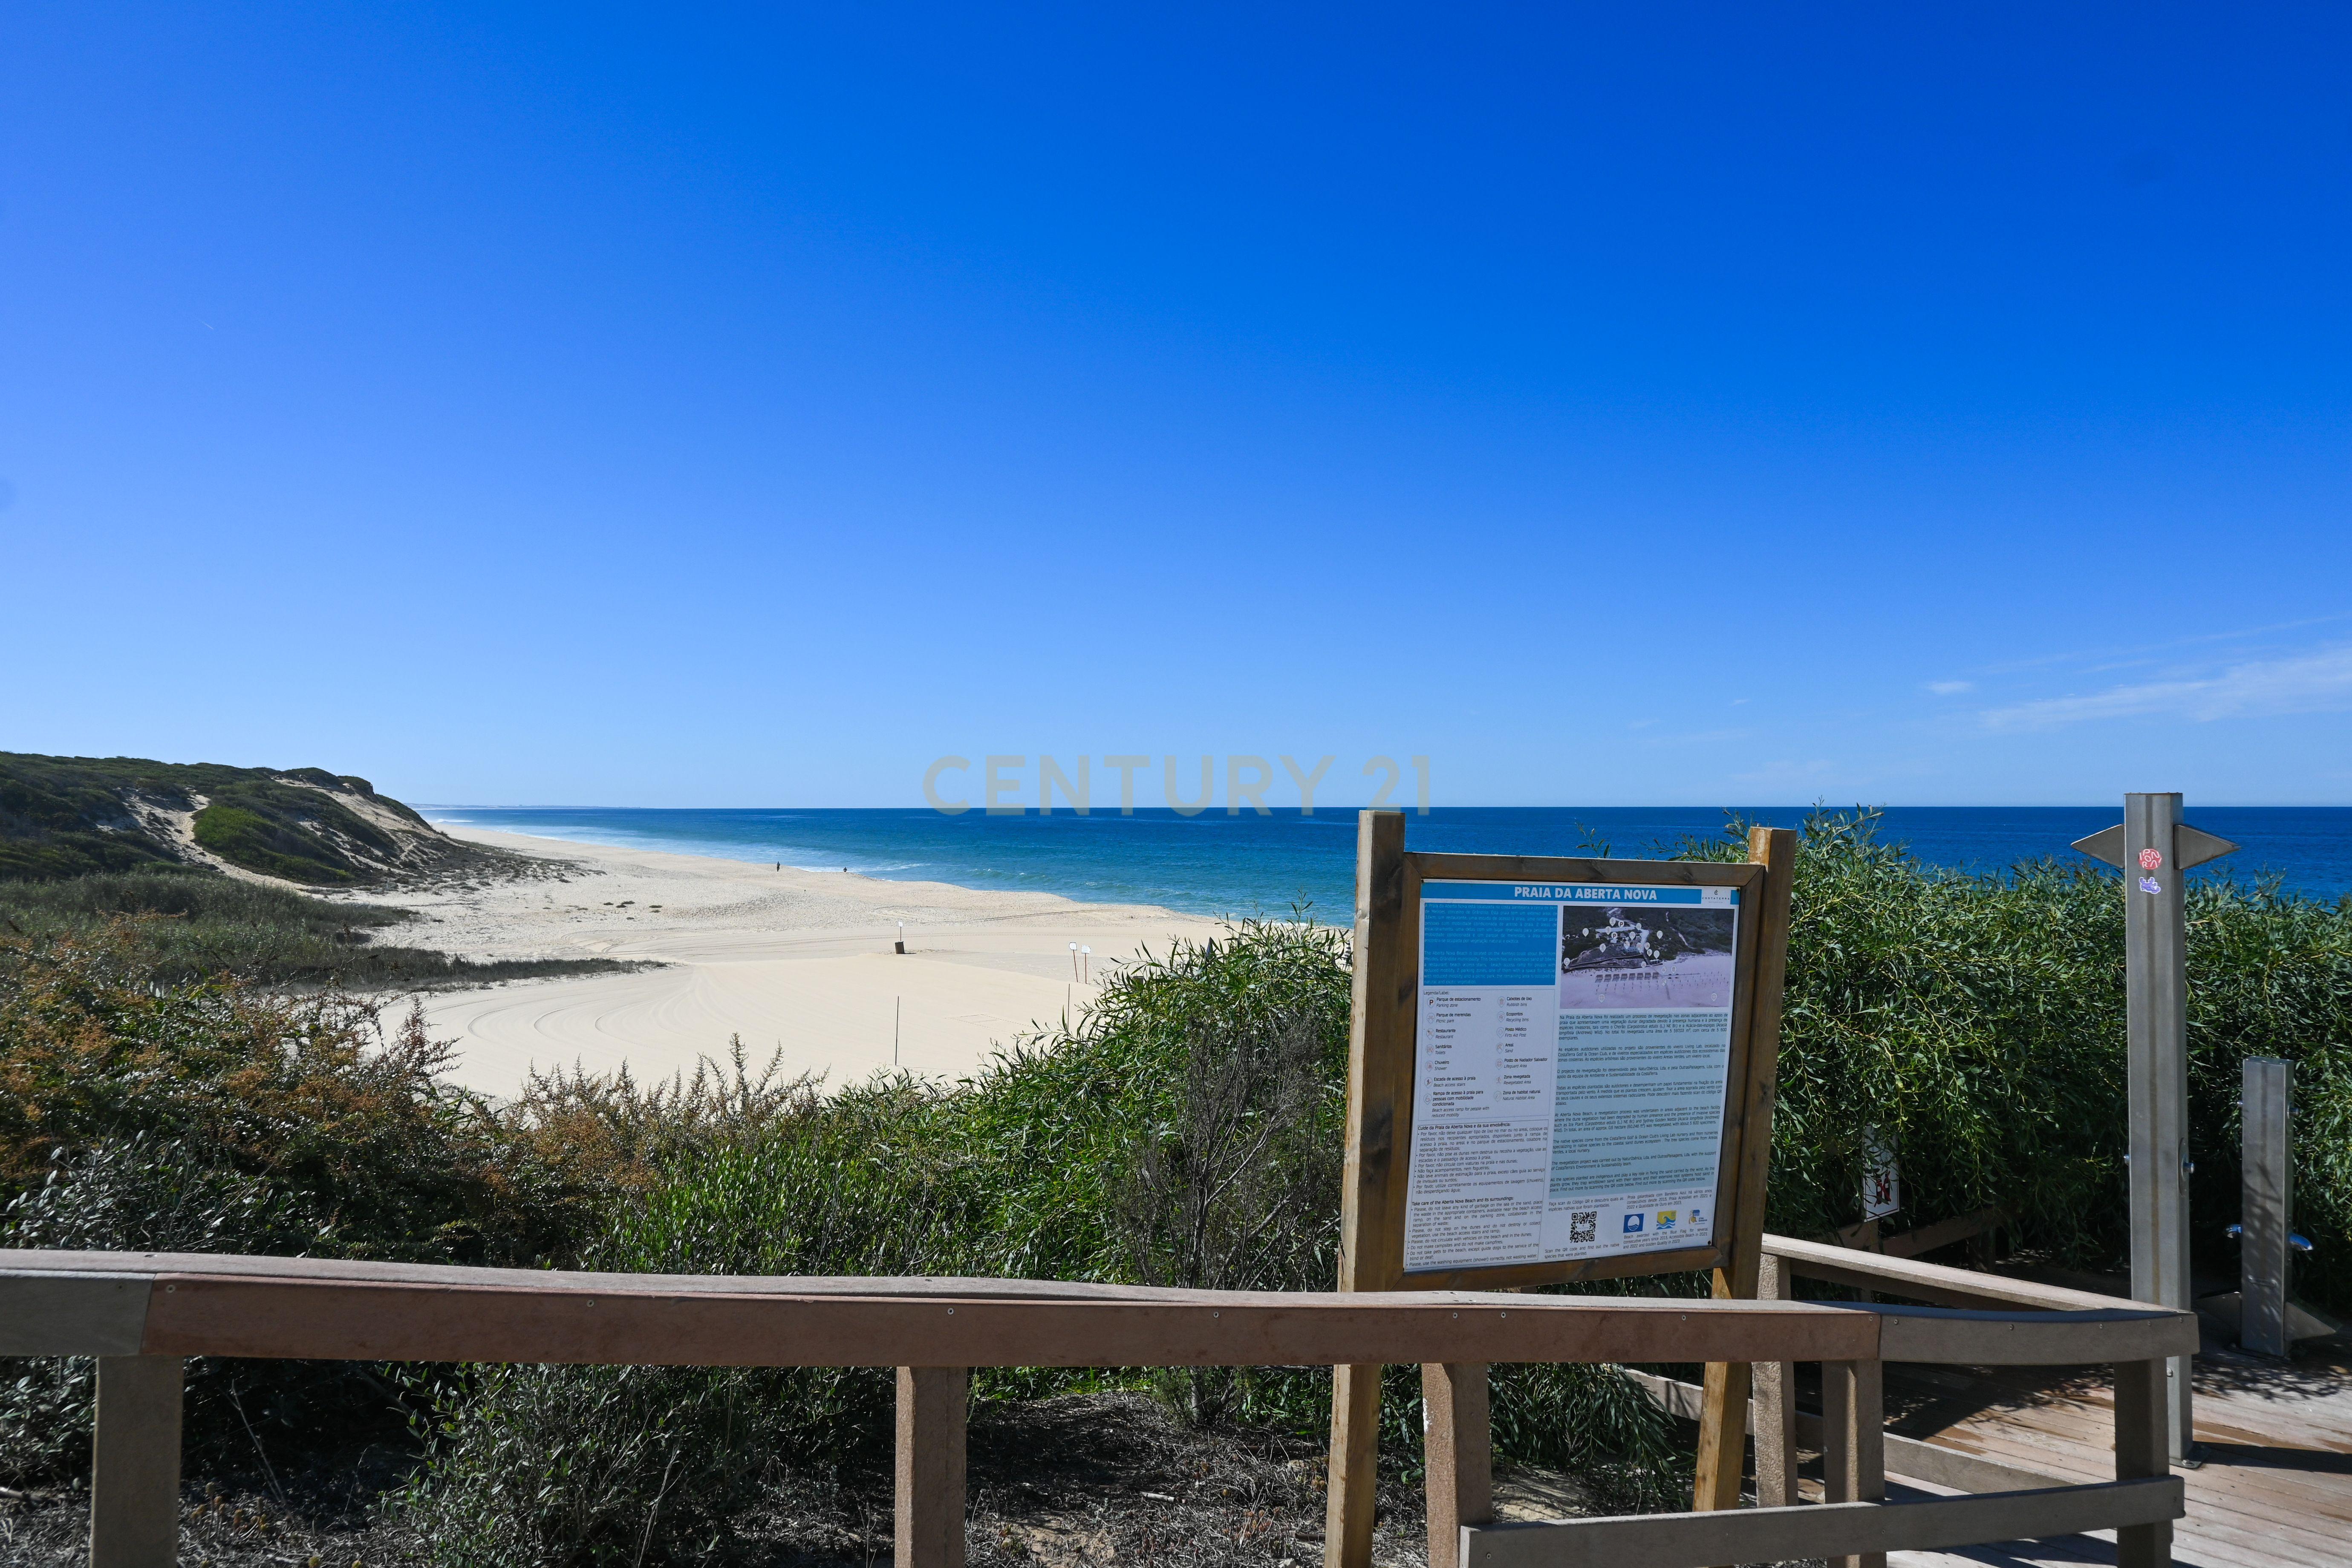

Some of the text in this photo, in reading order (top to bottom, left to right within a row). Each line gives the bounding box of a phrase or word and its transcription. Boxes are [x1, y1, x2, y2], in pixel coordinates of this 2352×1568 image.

[1514, 887, 1657, 900] PRAIA DA ABERTA NOVA
